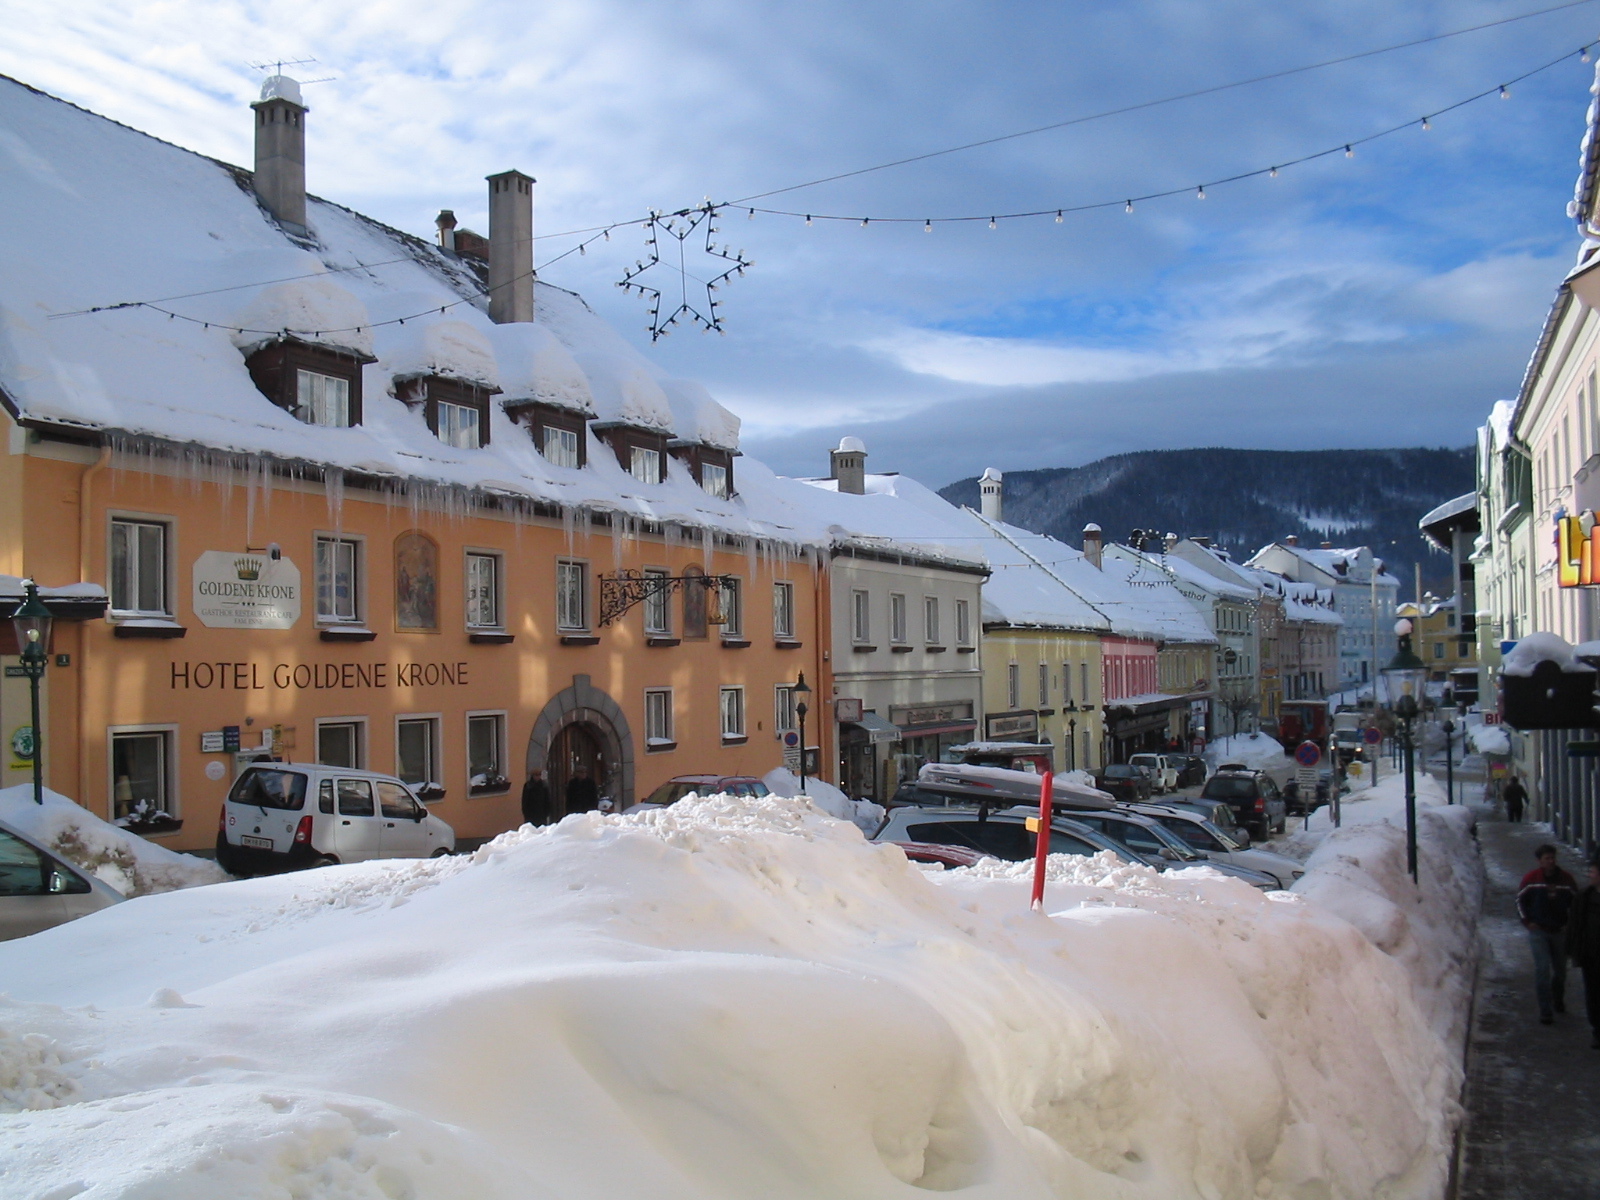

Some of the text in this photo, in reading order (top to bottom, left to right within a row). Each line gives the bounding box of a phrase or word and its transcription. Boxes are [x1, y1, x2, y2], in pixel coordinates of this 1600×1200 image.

[199, 581, 295, 600] GOLDENE KRONE
[171, 662, 468, 689] HOTEL GOLDENE KRONE
